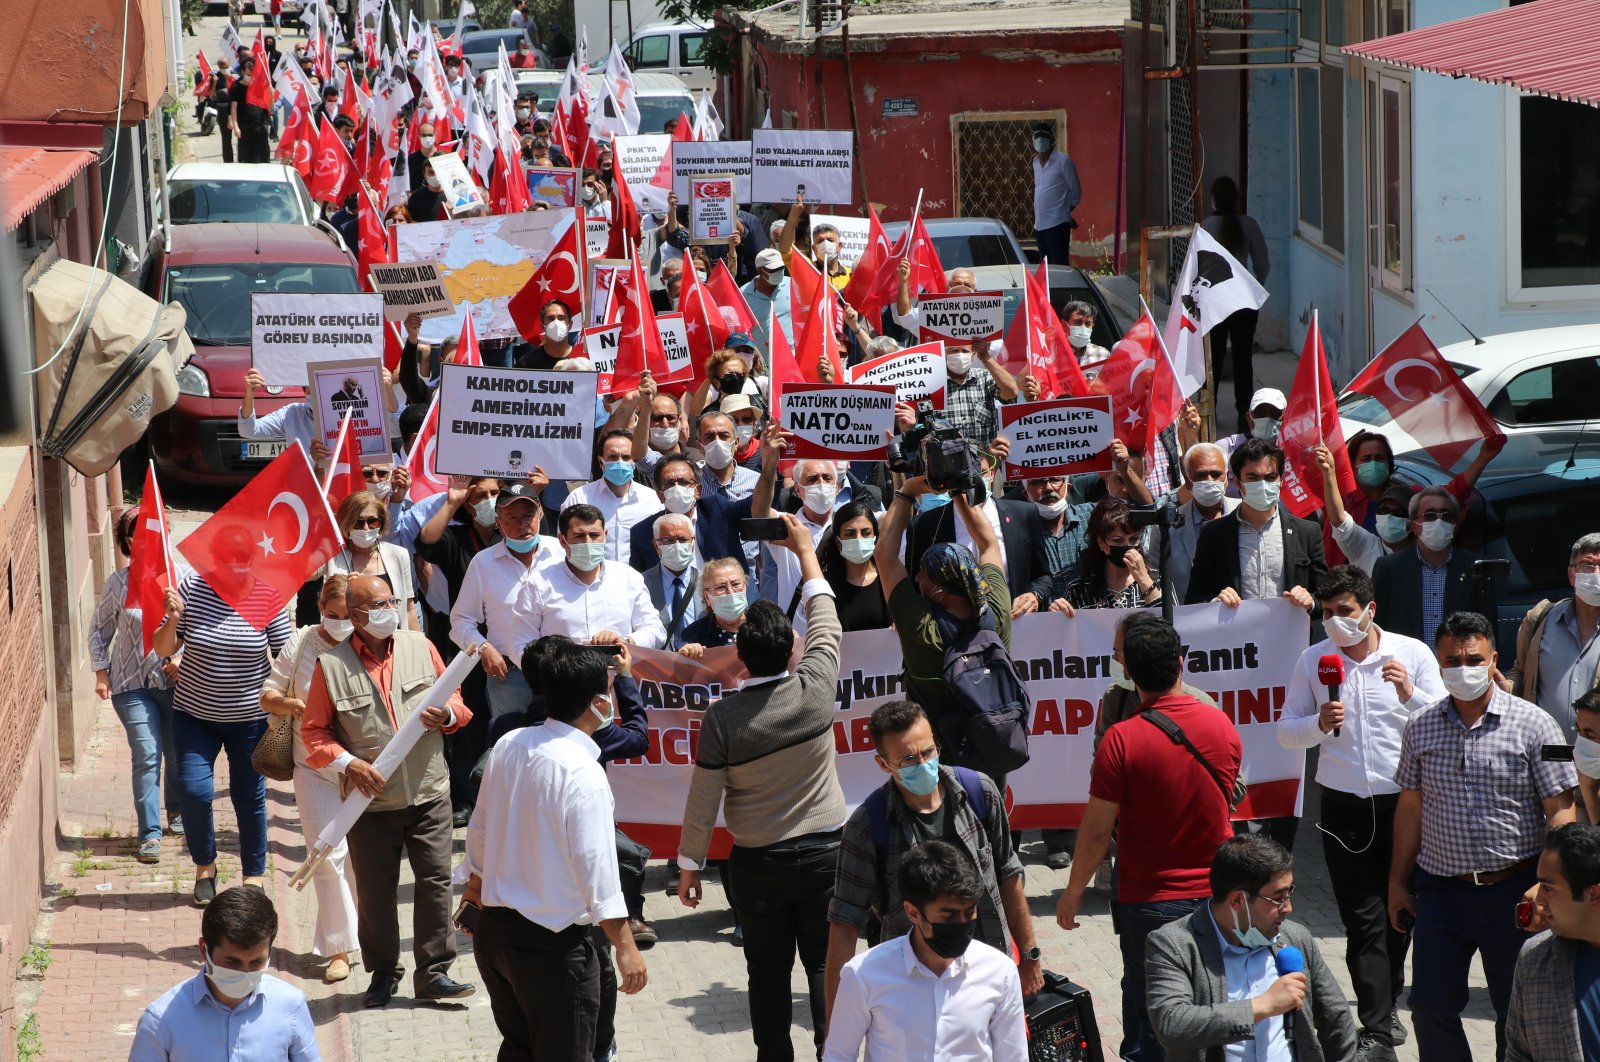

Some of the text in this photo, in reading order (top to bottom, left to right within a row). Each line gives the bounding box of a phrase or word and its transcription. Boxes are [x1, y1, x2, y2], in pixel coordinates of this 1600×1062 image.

[676, 157, 714, 165] SOYKIRIM
[826, 149, 849, 158] KARŞI
[755, 157, 849, 168] TÜRK MİLLETİ AYAKTA
[374, 265, 437, 284] KAHROLSUN ABD
[424, 286, 445, 303] PKK
[922, 299, 1001, 311] ATATÜRK DÜŞMANI
[256, 313, 380, 329] ATATÜRK GENÇLİĞİ
[926, 313, 971, 326] NATO
[950, 326, 994, 336] ÇIKALIM
[263, 331, 373, 347] GÖREV BAŞINDA
[595, 361, 608, 373] BU
[880, 367, 933, 383] KONSUN
[467, 376, 574, 394] KAHROLSUN
[471, 399, 566, 417] AMERİKAN
[787, 394, 892, 412] ATATÜRK DÜŞMANI
[338, 410, 365, 420] YAANI
[790, 412, 851, 431] NATO
[452, 420, 582, 440] EMPERYALİZMİ
[1016, 425, 1098, 441] EL KONSUN
[822, 433, 880, 447] ÇIKALIM
[1025, 440, 1091, 453] AMERİKA
[249, 444, 260, 456] 01
[1021, 453, 1098, 468] DEFOLSUN
